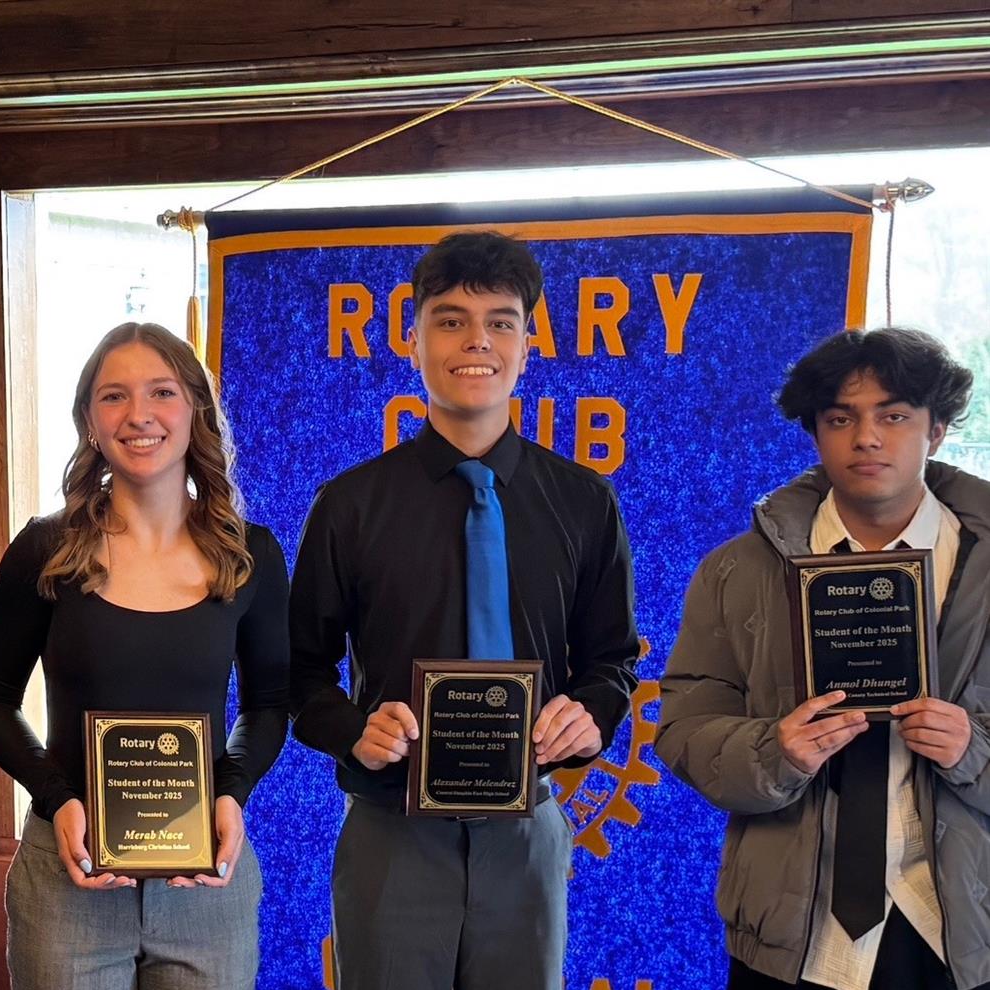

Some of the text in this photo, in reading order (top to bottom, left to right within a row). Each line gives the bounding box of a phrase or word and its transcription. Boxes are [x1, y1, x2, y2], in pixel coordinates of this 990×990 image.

[328, 273, 703, 359] ROARY
[383, 395, 626, 475] CUB
[828, 585, 866, 596] Rotary
[815, 625, 912, 637] Student of the Month
[831, 640, 874, 649] November
[826, 677, 907, 689] Anmol Dhungel
[448, 691, 483, 702] Rotary
[433, 730, 465, 738] Student
[467, 730, 476, 738] of
[491, 731, 519, 739] Month
[120, 738, 155, 750] Rotary
[108, 779, 195, 787] Student of the Month
[122, 792, 182, 800] November 2025
[124, 830, 184, 840] Merab Nace
